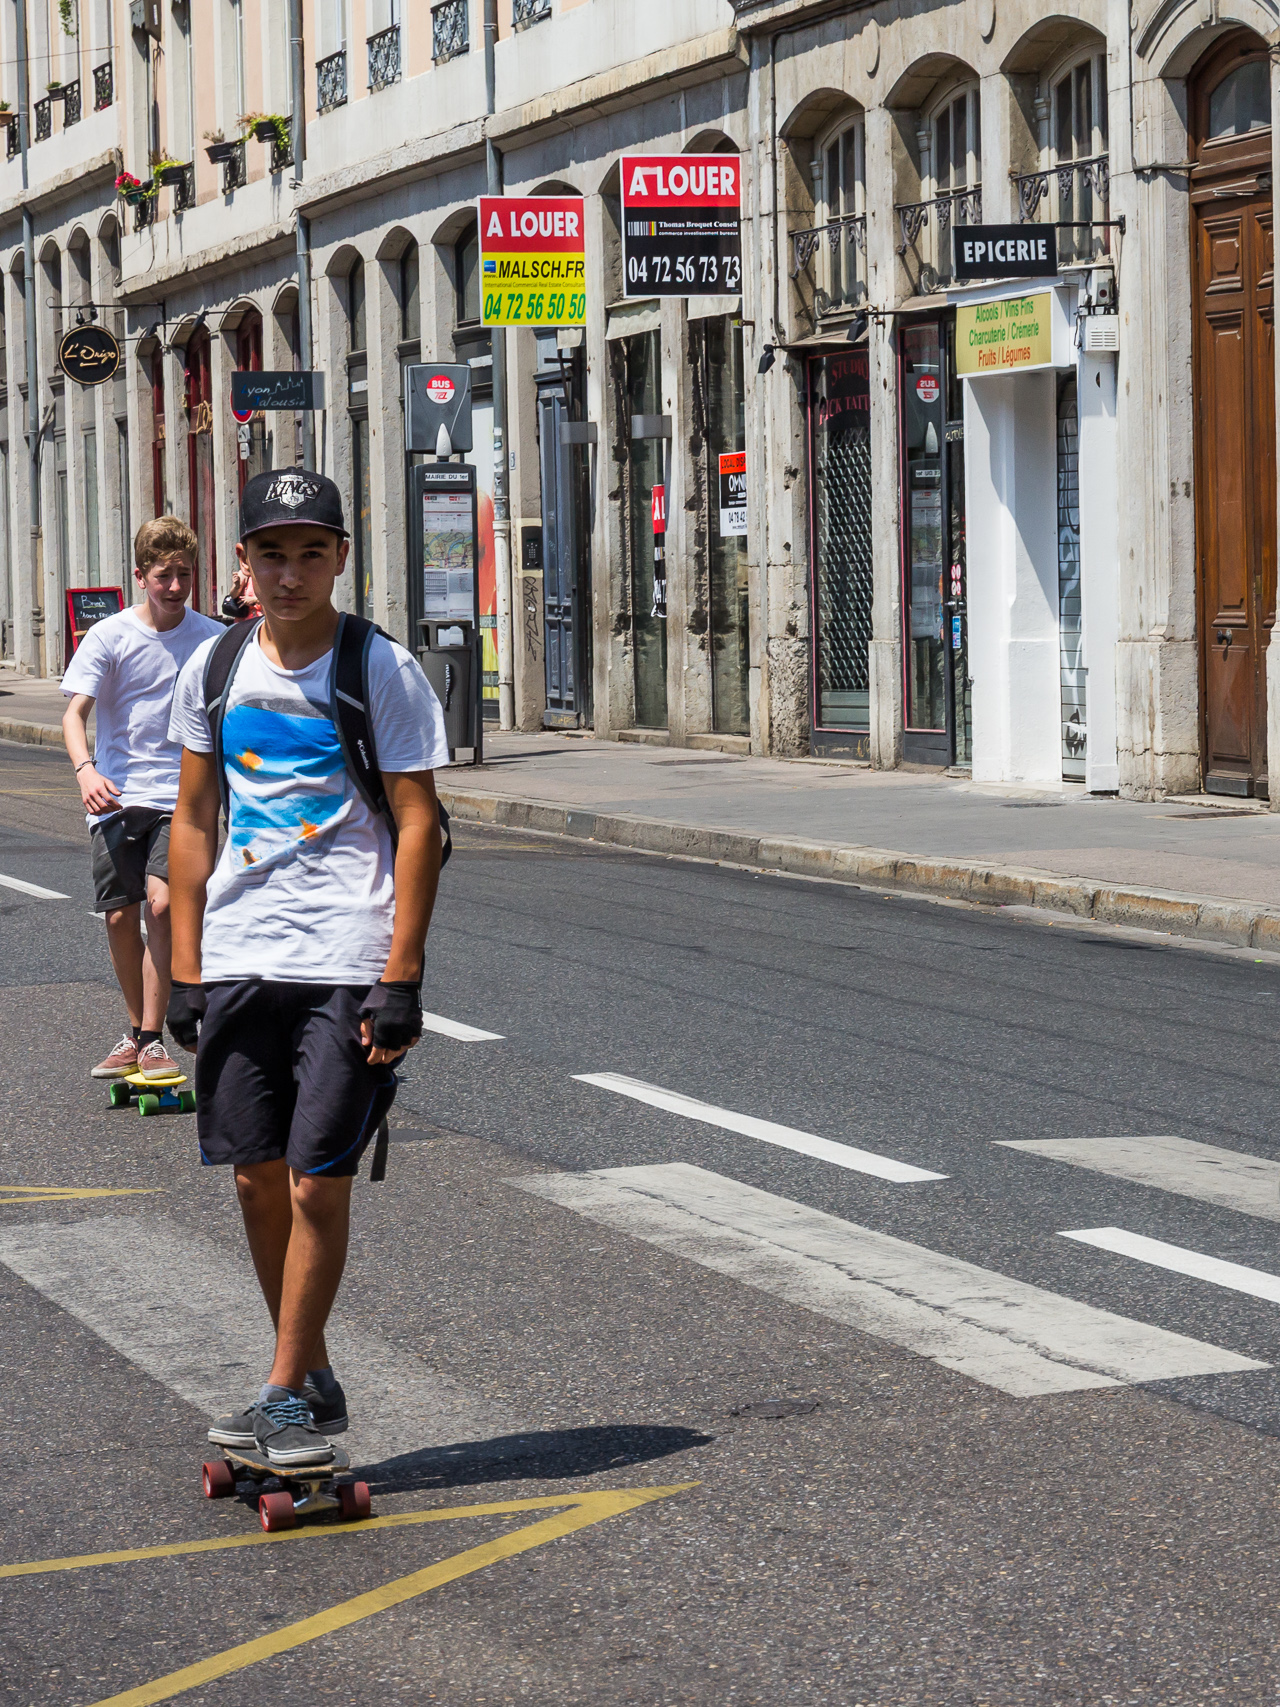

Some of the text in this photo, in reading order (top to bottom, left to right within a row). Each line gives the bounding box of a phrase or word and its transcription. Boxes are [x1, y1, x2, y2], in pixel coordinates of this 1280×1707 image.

[628, 165, 736, 196] A LOUER
[486, 211, 579, 237] A LOUER
[686, 221, 713, 229] Broquet
[963, 239, 1048, 263] EPICERIE
[628, 255, 741, 283] 04 72 56 73 73
[484, 293, 586, 320] 04 72 56 50 50
[975, 304, 999, 324] Alcools
[1003, 300, 1019, 318] Vins
[1020, 298, 1034, 316] Fins
[969, 325, 1006, 346] Charcuterie
[1011, 319, 1040, 340] Crémerie
[978, 348, 997, 368] Fruits
[1001, 345, 1031, 367] Légumes
[431, 380, 450, 388] BUS
[832, 359, 869, 388] STUDIO
[242, 385, 270, 397] Lyon
[252, 396, 306, 406] Jalousie
[722, 458, 735, 469] LOCAL
[265, 481, 321, 500] KINGS
